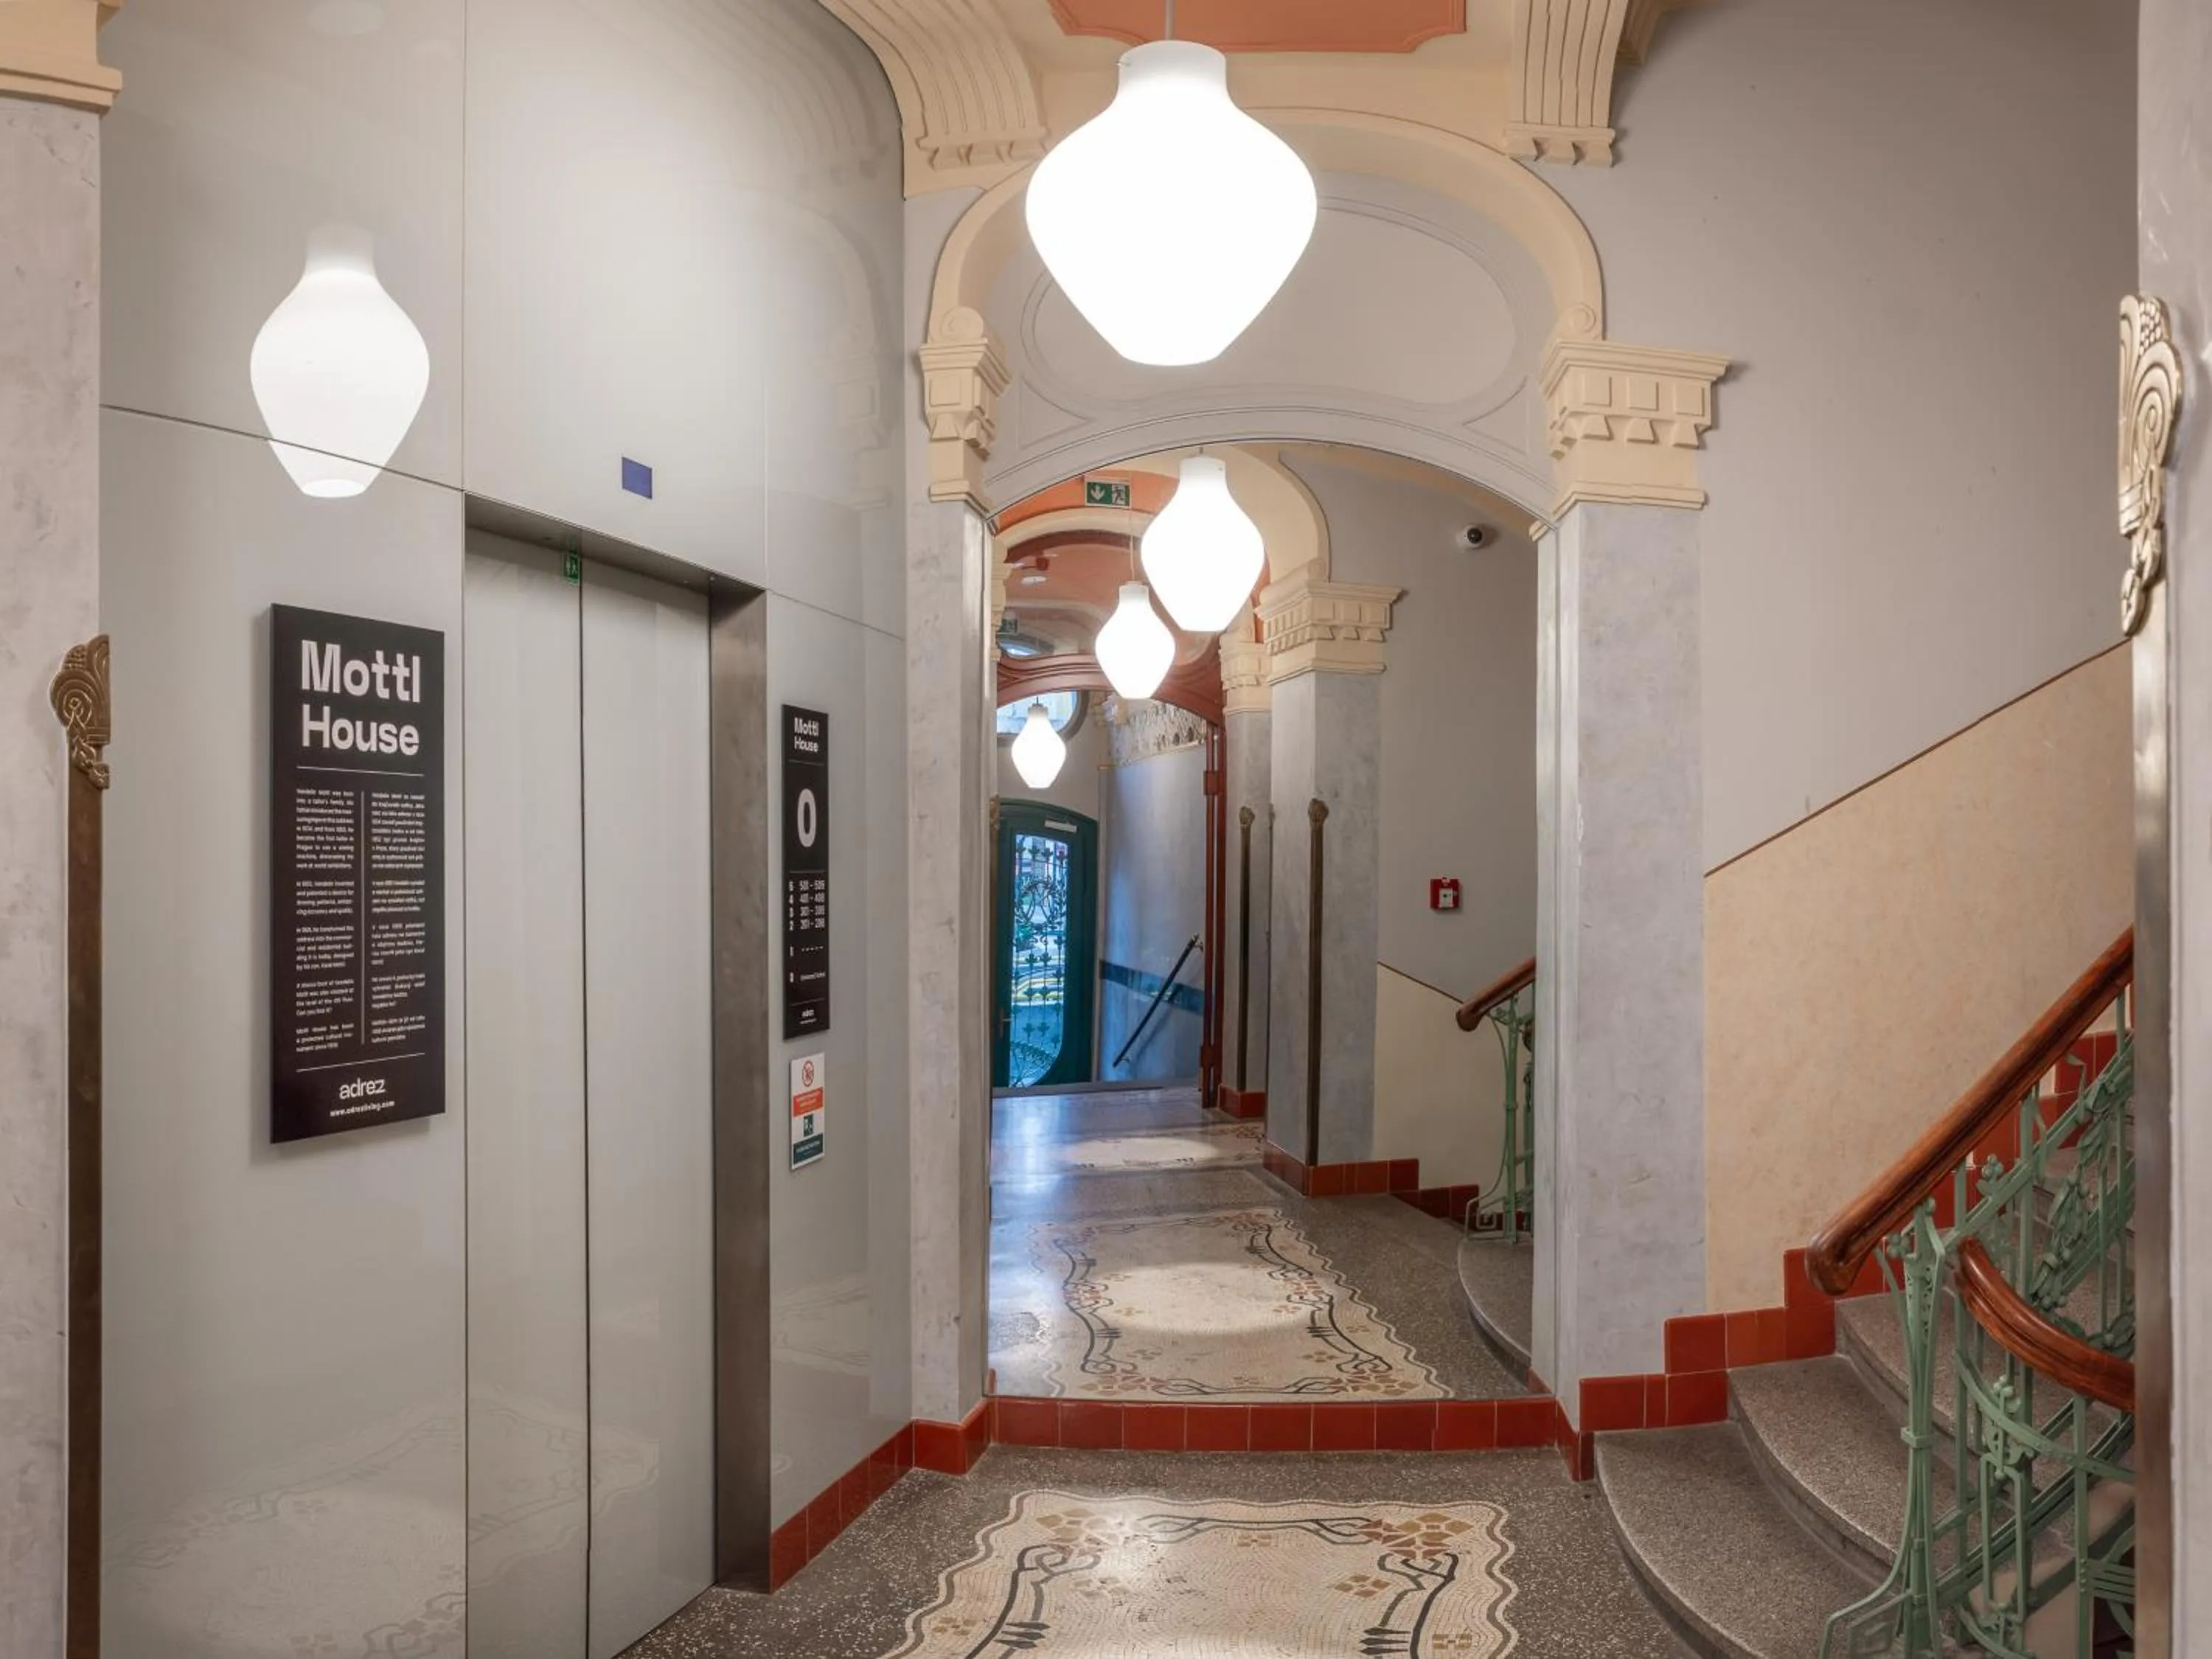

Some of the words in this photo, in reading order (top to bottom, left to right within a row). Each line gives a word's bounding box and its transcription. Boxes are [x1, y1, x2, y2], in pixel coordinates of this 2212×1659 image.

[301, 639, 421, 703] Mottl
[302, 703, 420, 756] House
[794, 717, 819, 737] Mottl
[794, 736, 818, 752] House
[797, 787, 817, 848] 0
[340, 1077, 386, 1099] adrez
